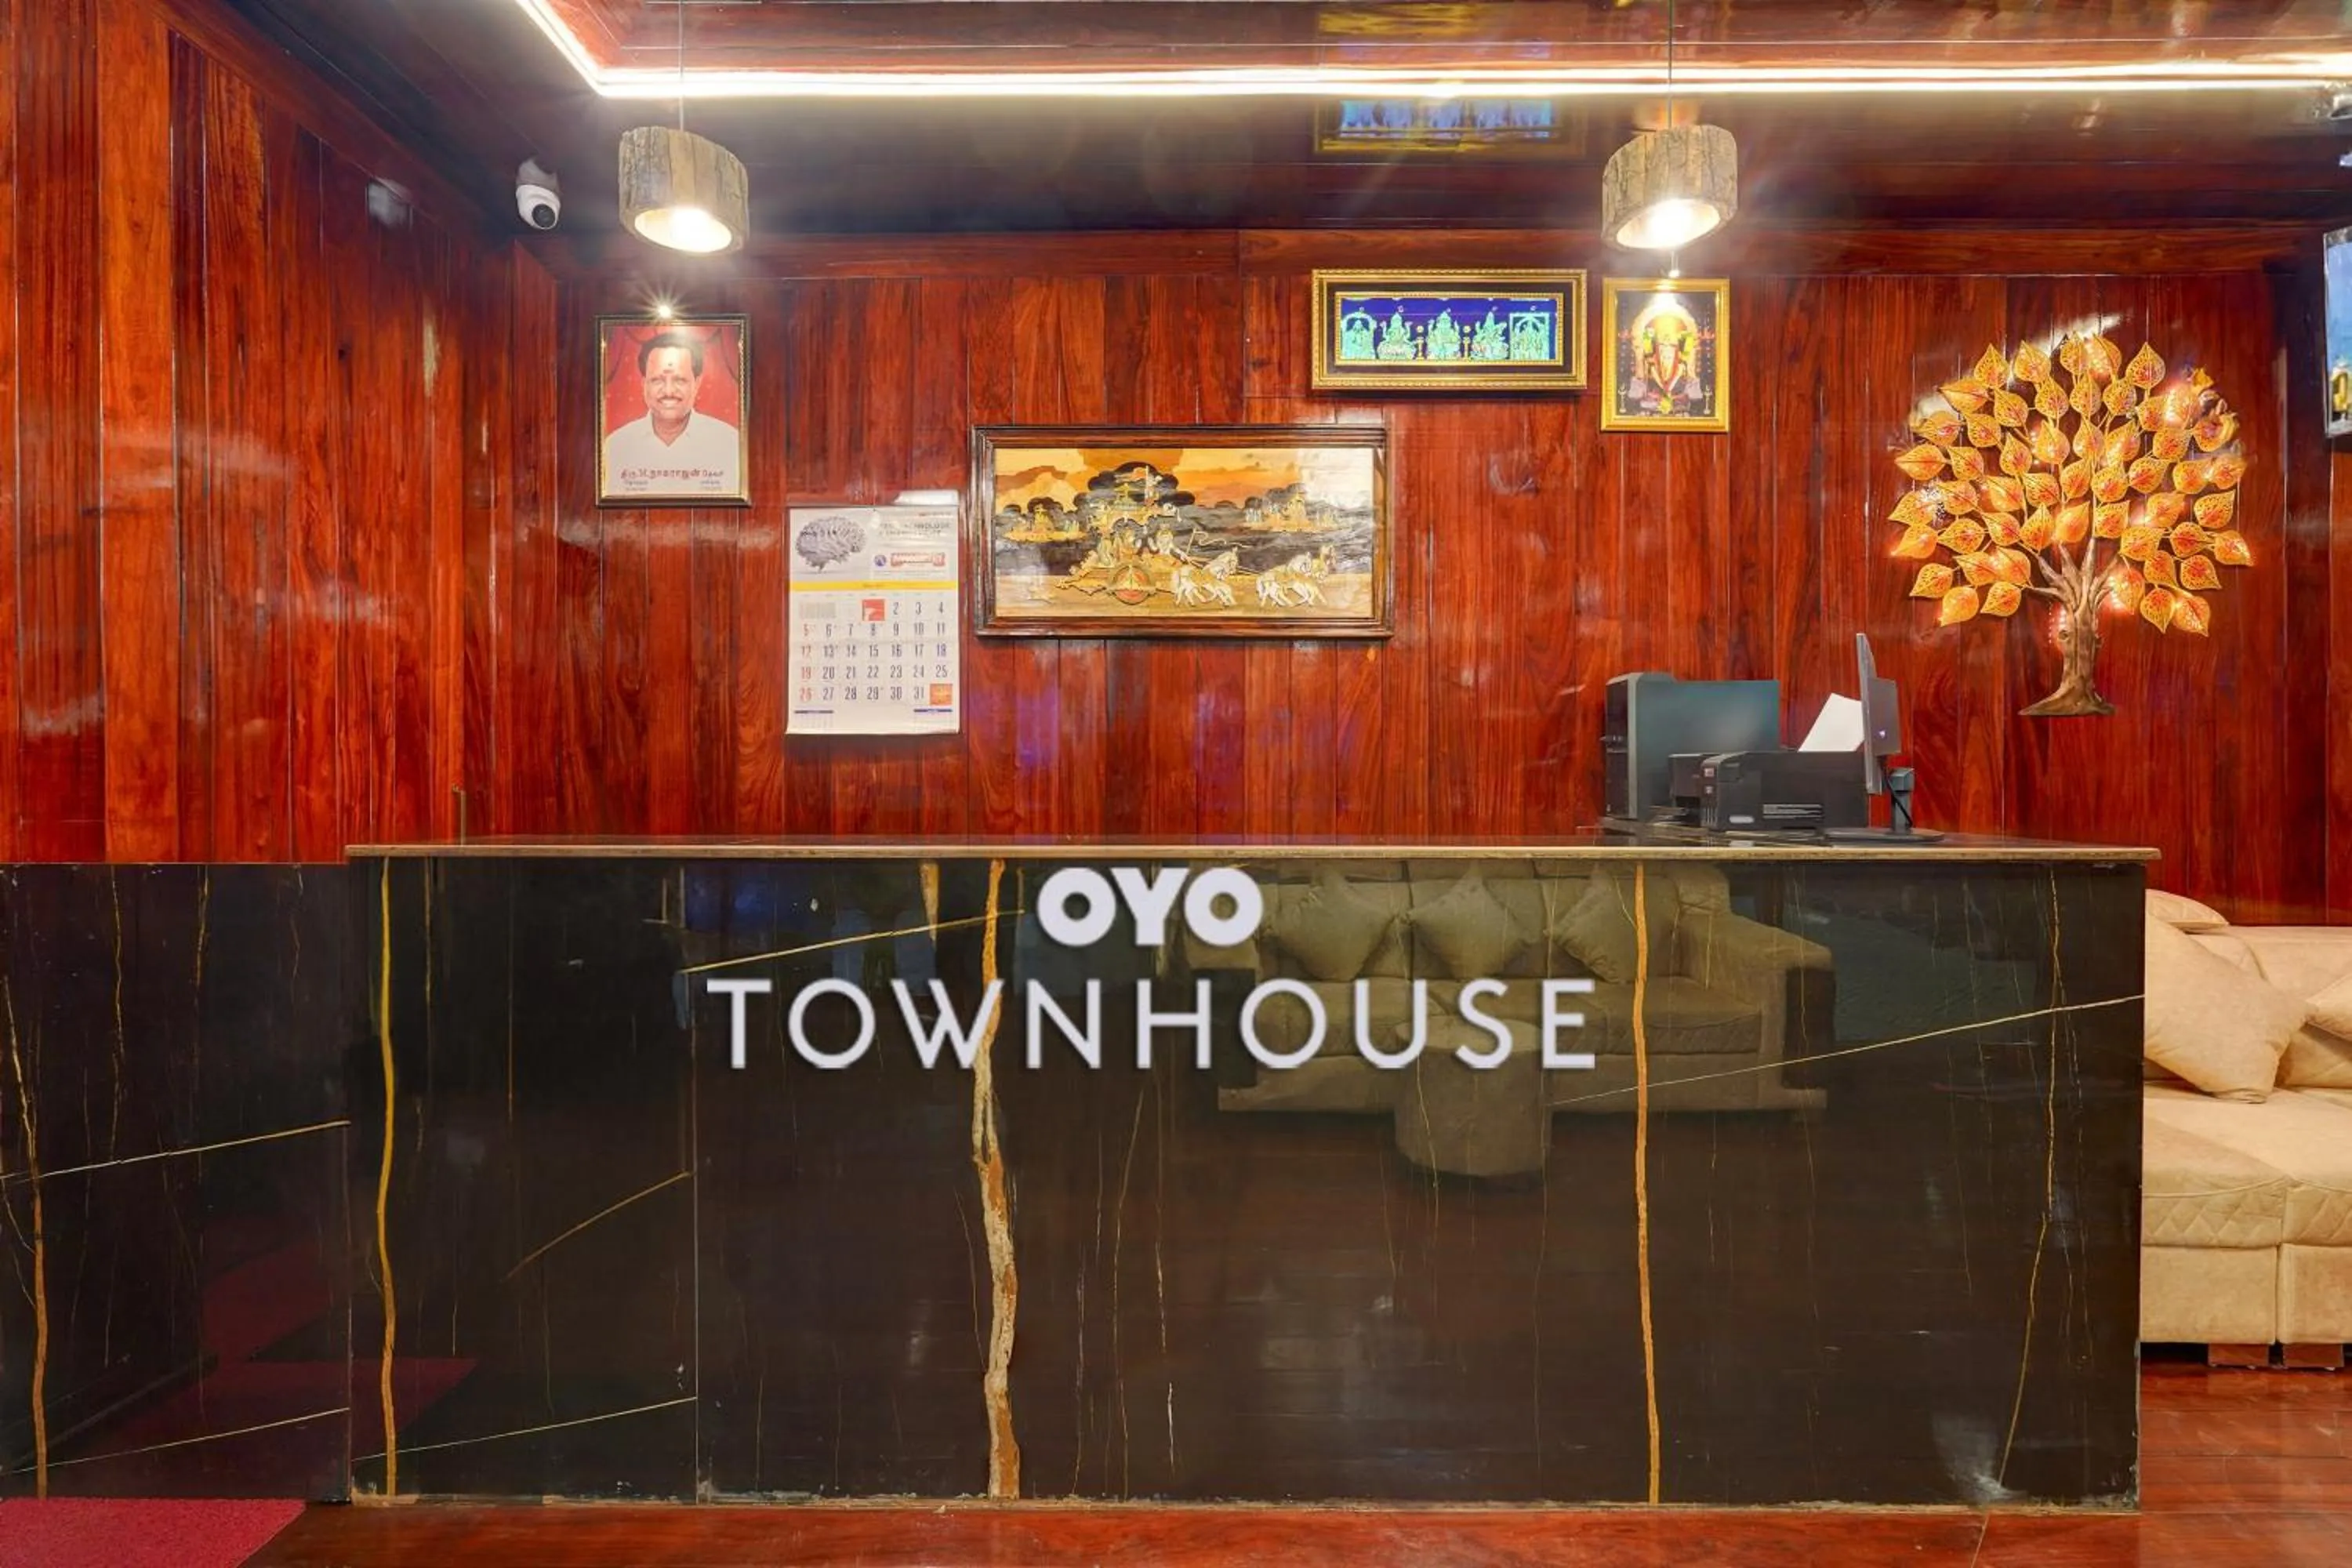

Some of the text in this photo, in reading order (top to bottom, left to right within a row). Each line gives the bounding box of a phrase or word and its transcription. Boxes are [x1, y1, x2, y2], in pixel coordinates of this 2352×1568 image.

[892, 601, 944, 615] 2 3 4
[804, 623, 809, 637] 5
[826, 623, 832, 637] 6
[848, 623, 854, 637] 7
[893, 622, 899, 636] 9
[913, 622, 924, 635] 10
[937, 622, 945, 636] 11
[847, 644, 856, 658] 14
[869, 644, 879, 657] 15
[891, 644, 902, 657] 16
[914, 643, 924, 658] 17
[936, 643, 946, 657] 18
[801, 666, 811, 680] 19
[822, 666, 835, 679] 20
[846, 666, 856, 679] 21
[867, 665, 879, 678] 22
[890, 665, 902, 678] 23
[935, 665, 948, 678] 25
[822, 686, 835, 700] 27
[844, 686, 857, 700] 28
[866, 686, 879, 700] 29
[890, 686, 902, 700] 30
[913, 686, 924, 699] 31
[1037, 867, 1263, 946] OYO
[706, 979, 1596, 1069] TOWNHOUSE
